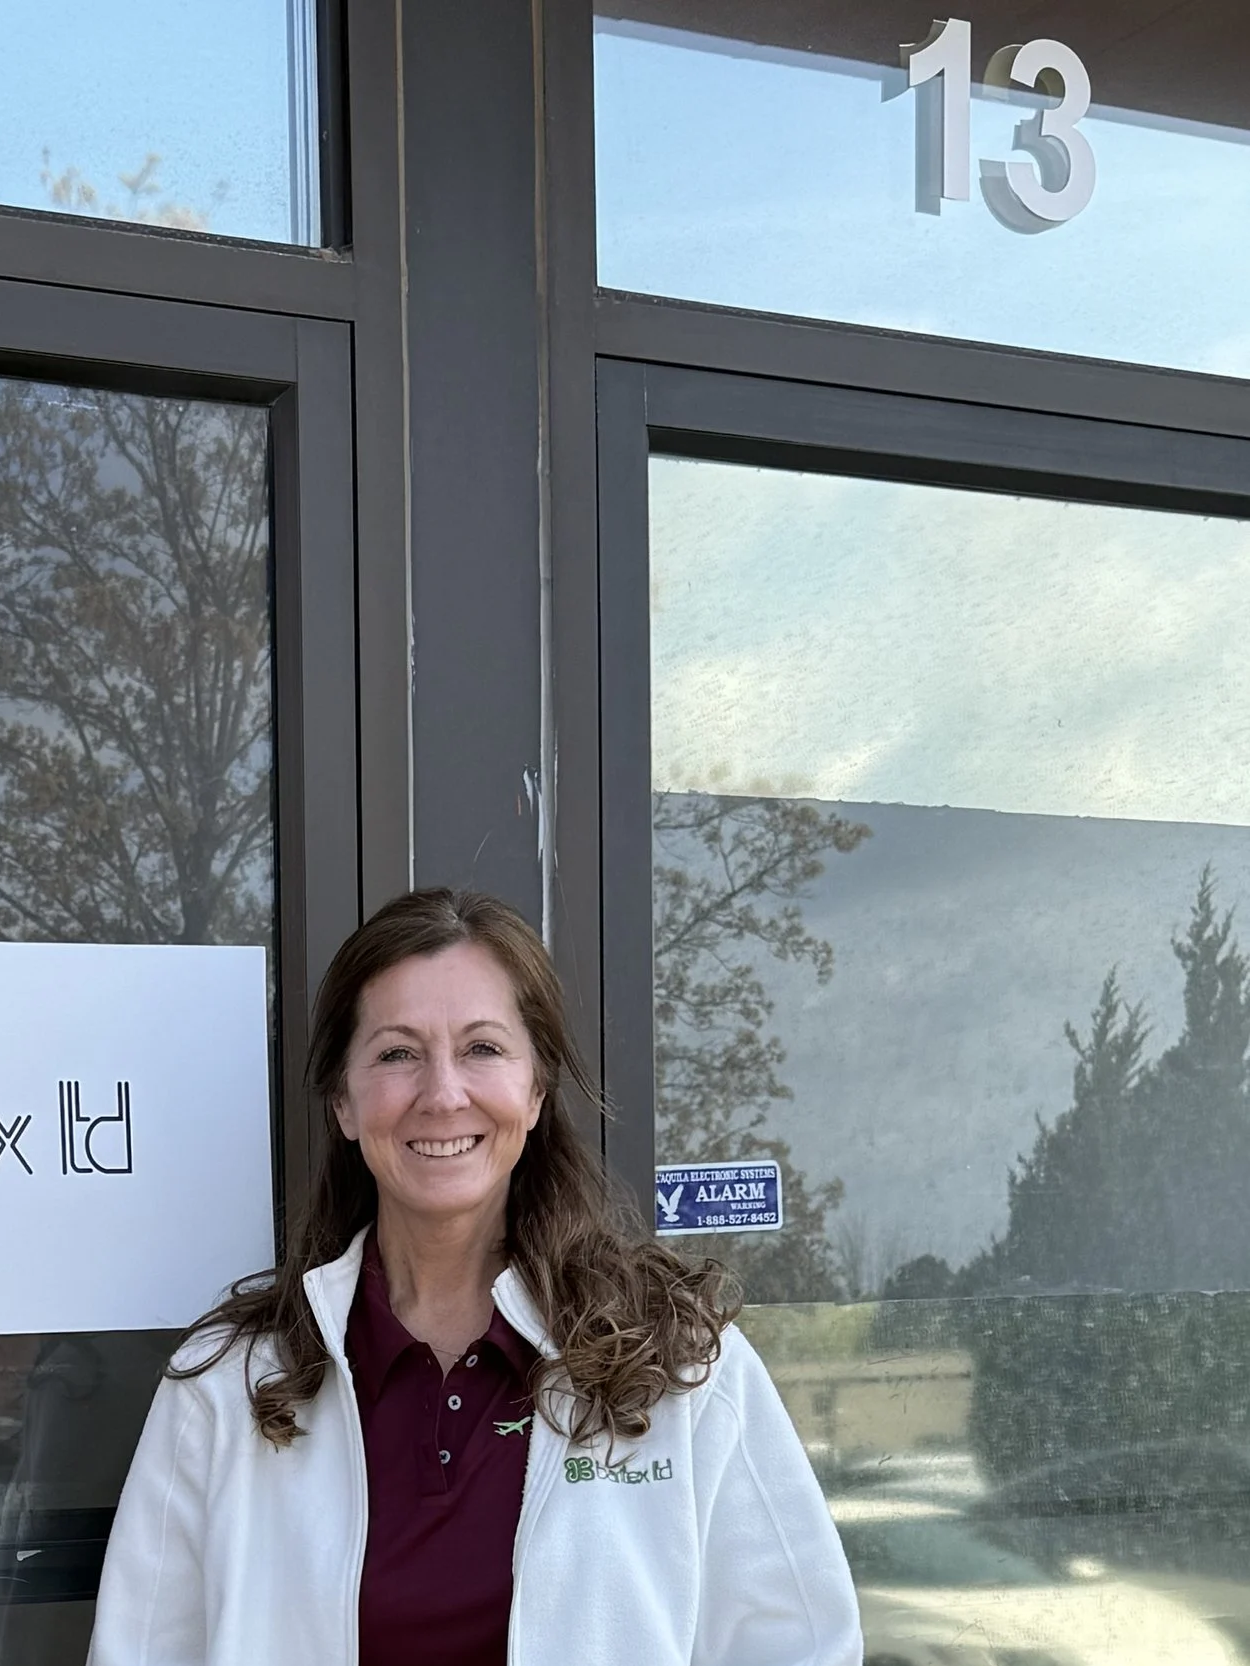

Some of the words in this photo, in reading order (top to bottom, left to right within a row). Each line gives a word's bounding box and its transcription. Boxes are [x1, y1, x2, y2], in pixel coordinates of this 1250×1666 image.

[909, 17, 1096, 222] 13
[58, 1080, 134, 1176] ltd
[690, 1170, 739, 1182] ELECTRONIC
[740, 1168, 776, 1179] SYSTEMS
[695, 1182, 766, 1202] ALARM
[730, 1202, 766, 1210] WARNING
[697, 1212, 777, 1226] 1-888-527-8452
